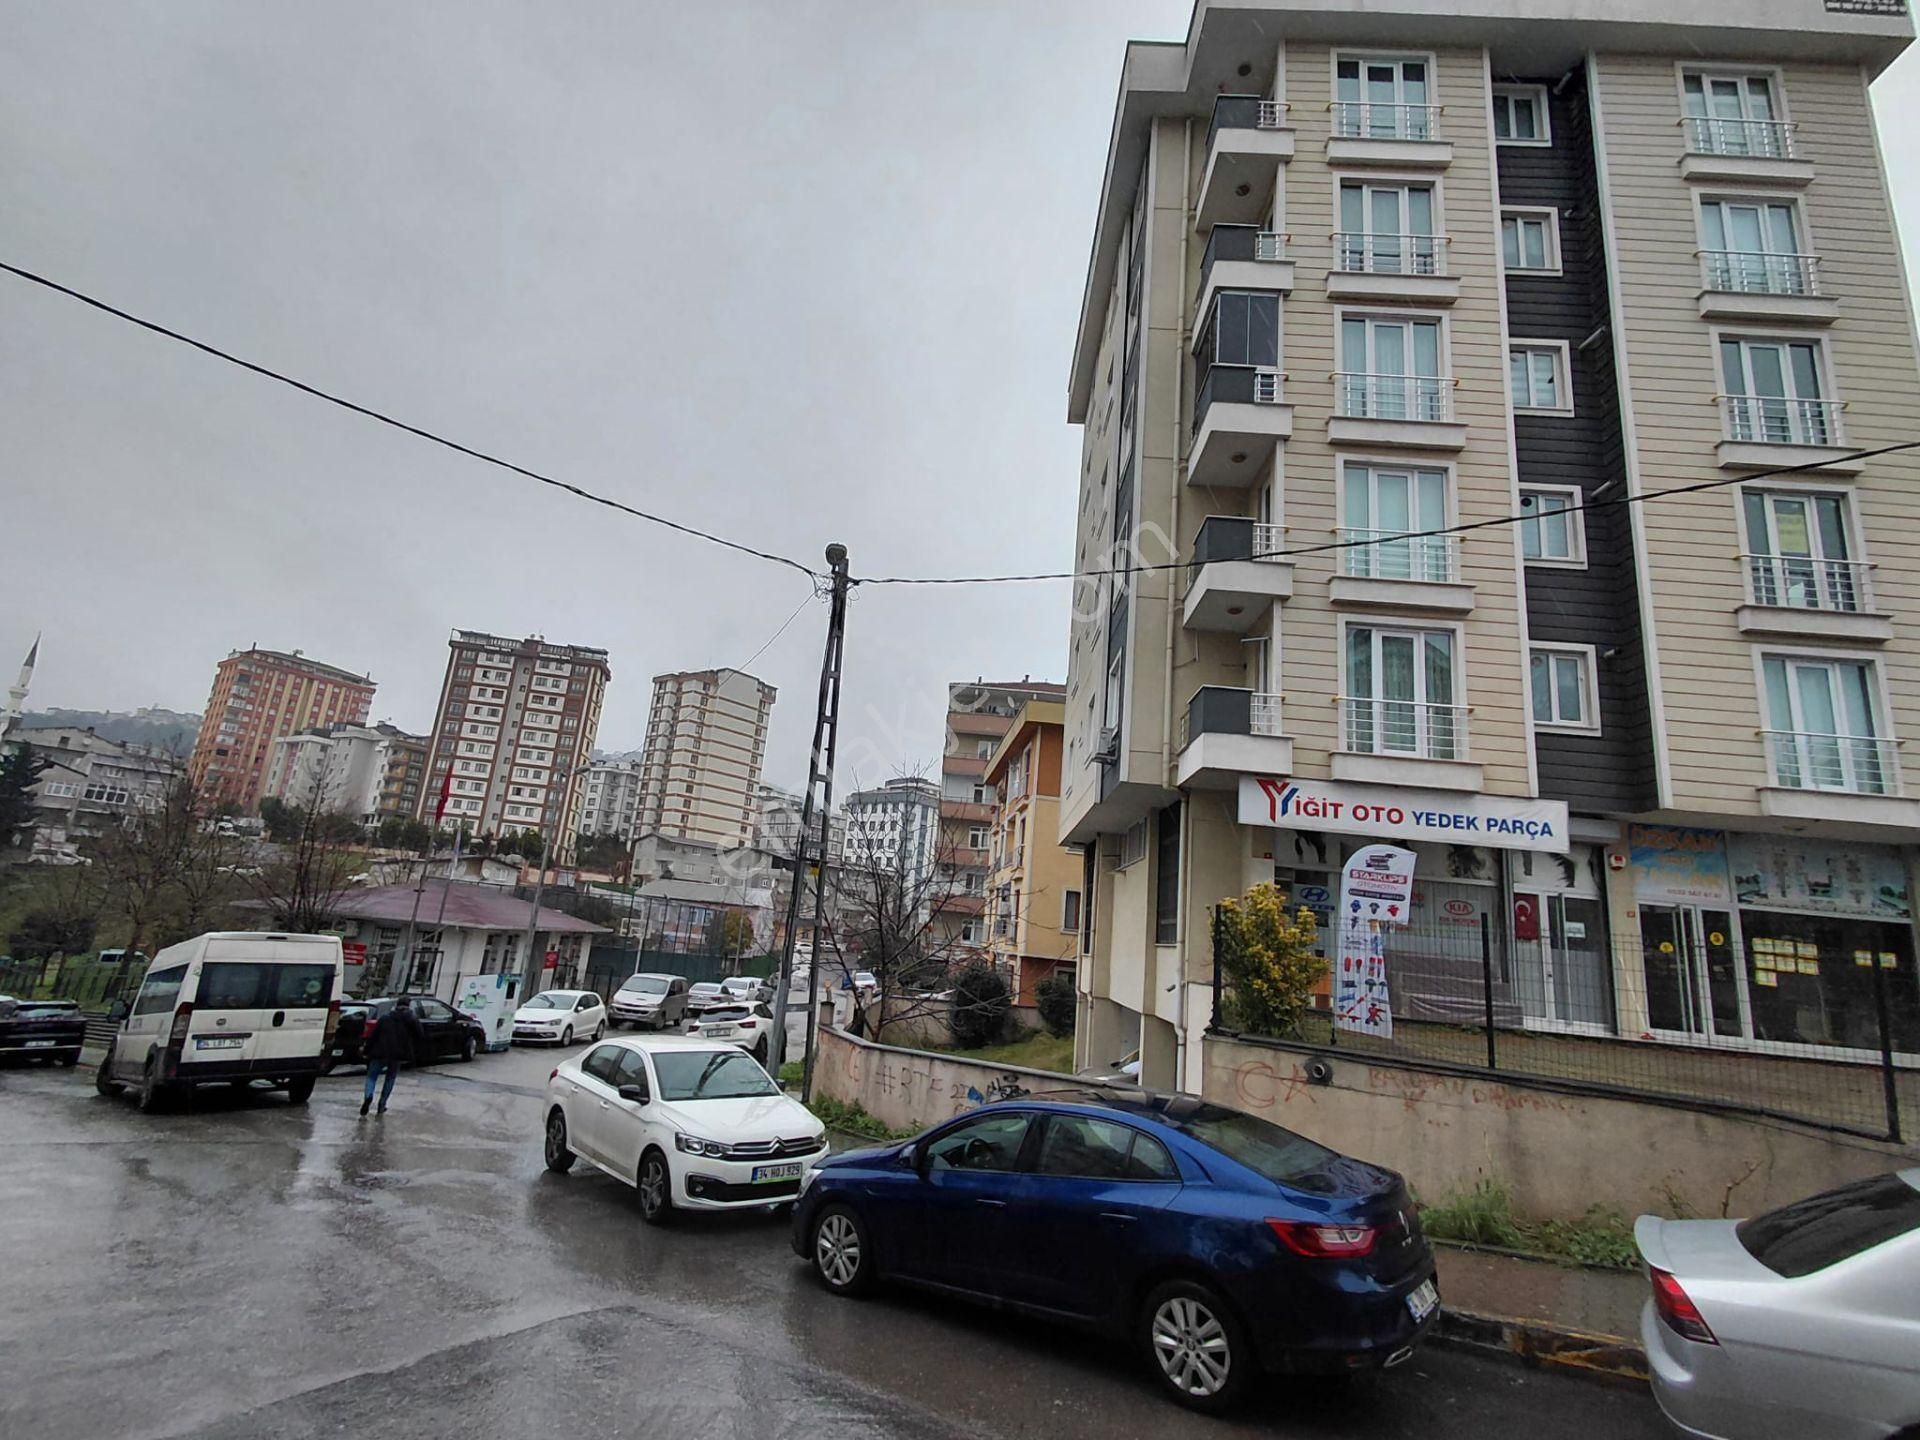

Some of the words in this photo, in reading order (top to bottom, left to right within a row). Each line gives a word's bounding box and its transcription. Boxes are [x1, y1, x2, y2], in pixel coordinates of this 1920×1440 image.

[1352, 804, 1404, 825] OTO
[1412, 810, 1479, 832] YEDEK
[1486, 817, 1553, 841] PARÇA
[1448, 903, 1470, 913] KIA
[758, 1169, 768, 1179] 34
